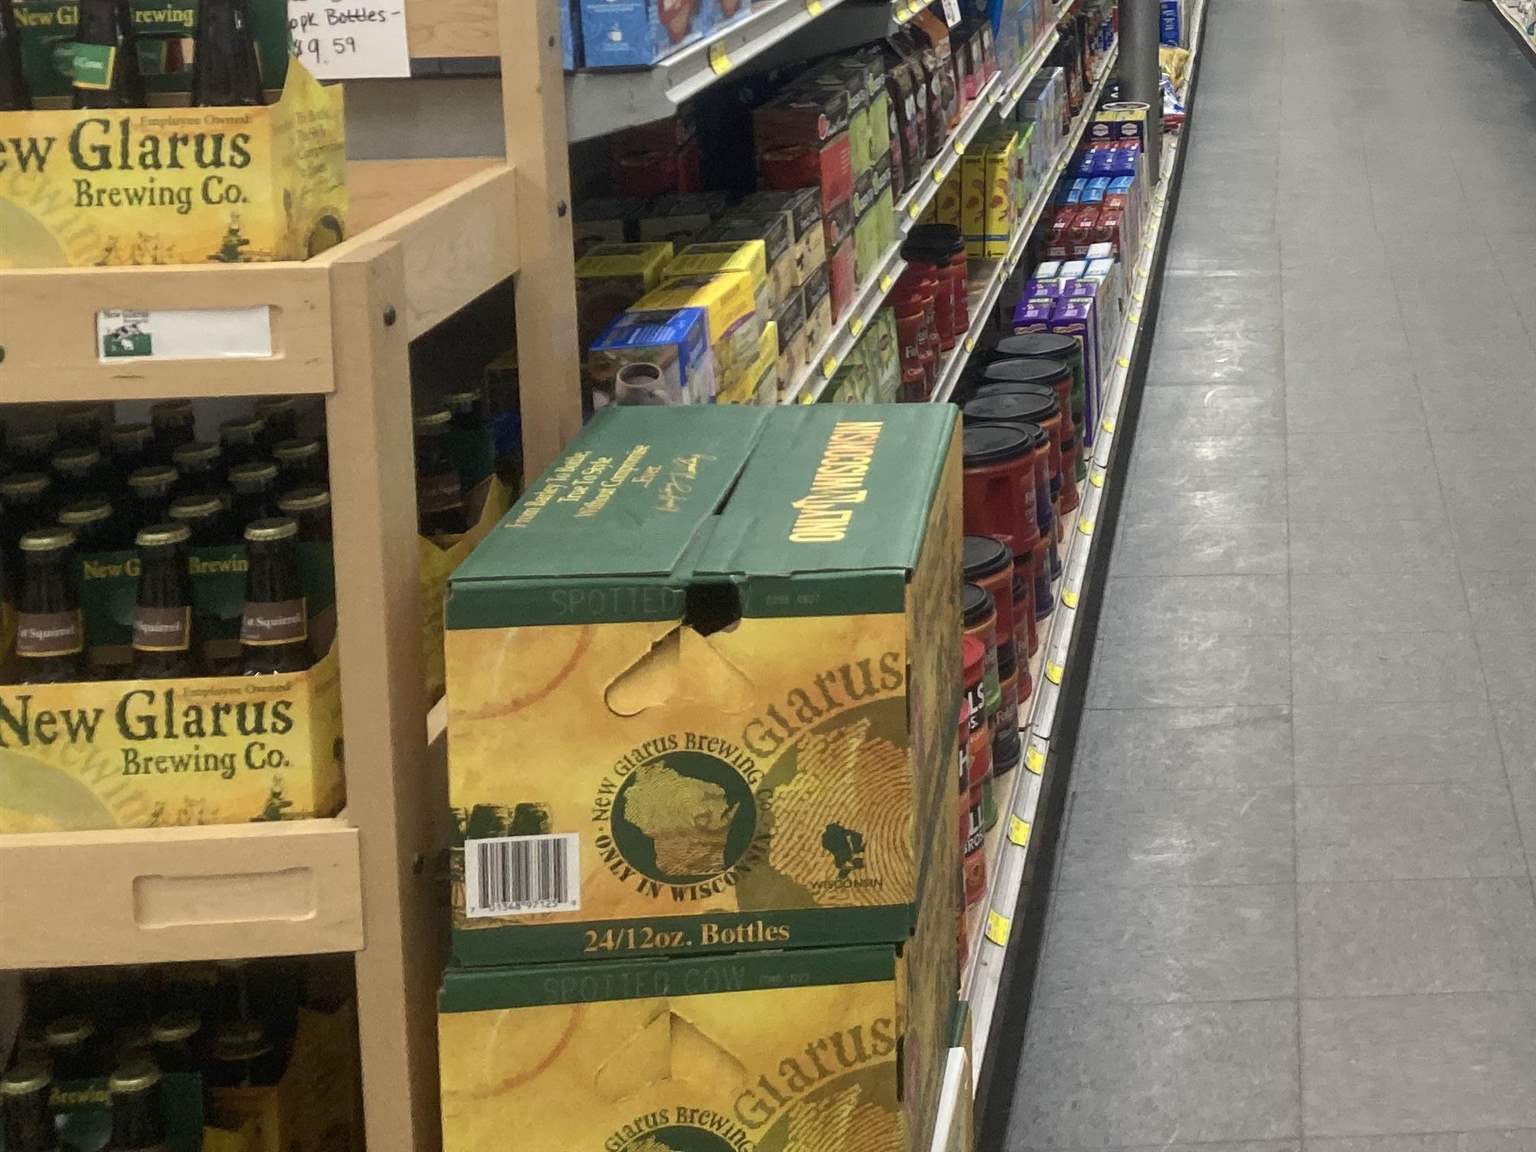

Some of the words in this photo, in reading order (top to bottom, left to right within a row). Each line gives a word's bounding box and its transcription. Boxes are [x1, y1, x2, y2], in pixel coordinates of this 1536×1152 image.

[131, 4, 194, 27] rewing
[325, 8, 387, 26] Bottles
[68, 116, 251, 172] Glarus
[73, 176, 192, 215] Brewing
[201, 175, 249, 205] Co.
[811, 420, 883, 490] WISCONSIN
[788, 509, 853, 542] ONLY
[188, 554, 249, 575] Brewin
[0, 694, 104, 748] New
[115, 687, 294, 741] Glarus
[742, 651, 905, 759] Glarus
[121, 745, 236, 779] Brewing
[244, 741, 290, 770] Co.
[594, 834, 638, 889] ONLY
[637, 877, 663, 900] IN
[811, 878, 883, 890] WISCONSIN
[584, 927, 692, 953] 24/12oz.
[701, 920, 790, 945] Bottles
